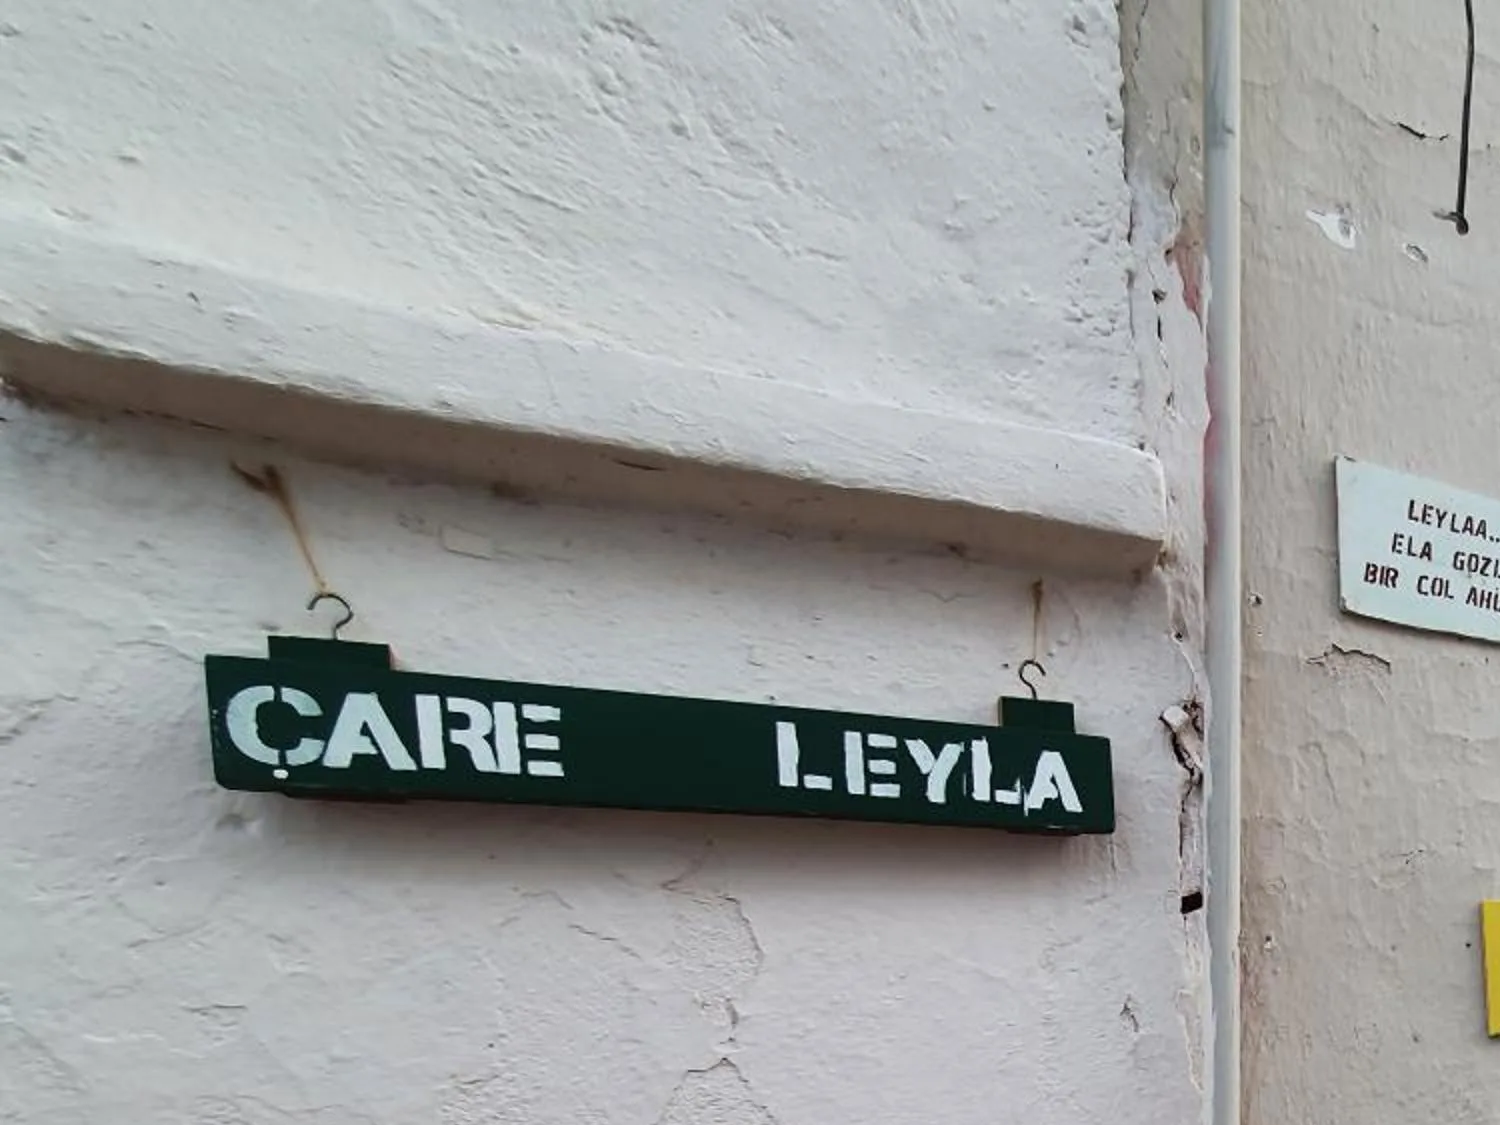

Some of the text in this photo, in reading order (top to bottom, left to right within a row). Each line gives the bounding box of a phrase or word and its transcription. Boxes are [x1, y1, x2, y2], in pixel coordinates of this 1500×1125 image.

[1391, 532, 1433, 562] ELA
[1363, 562, 1399, 589] BIR
[775, 721, 1082, 815] LEYLA
